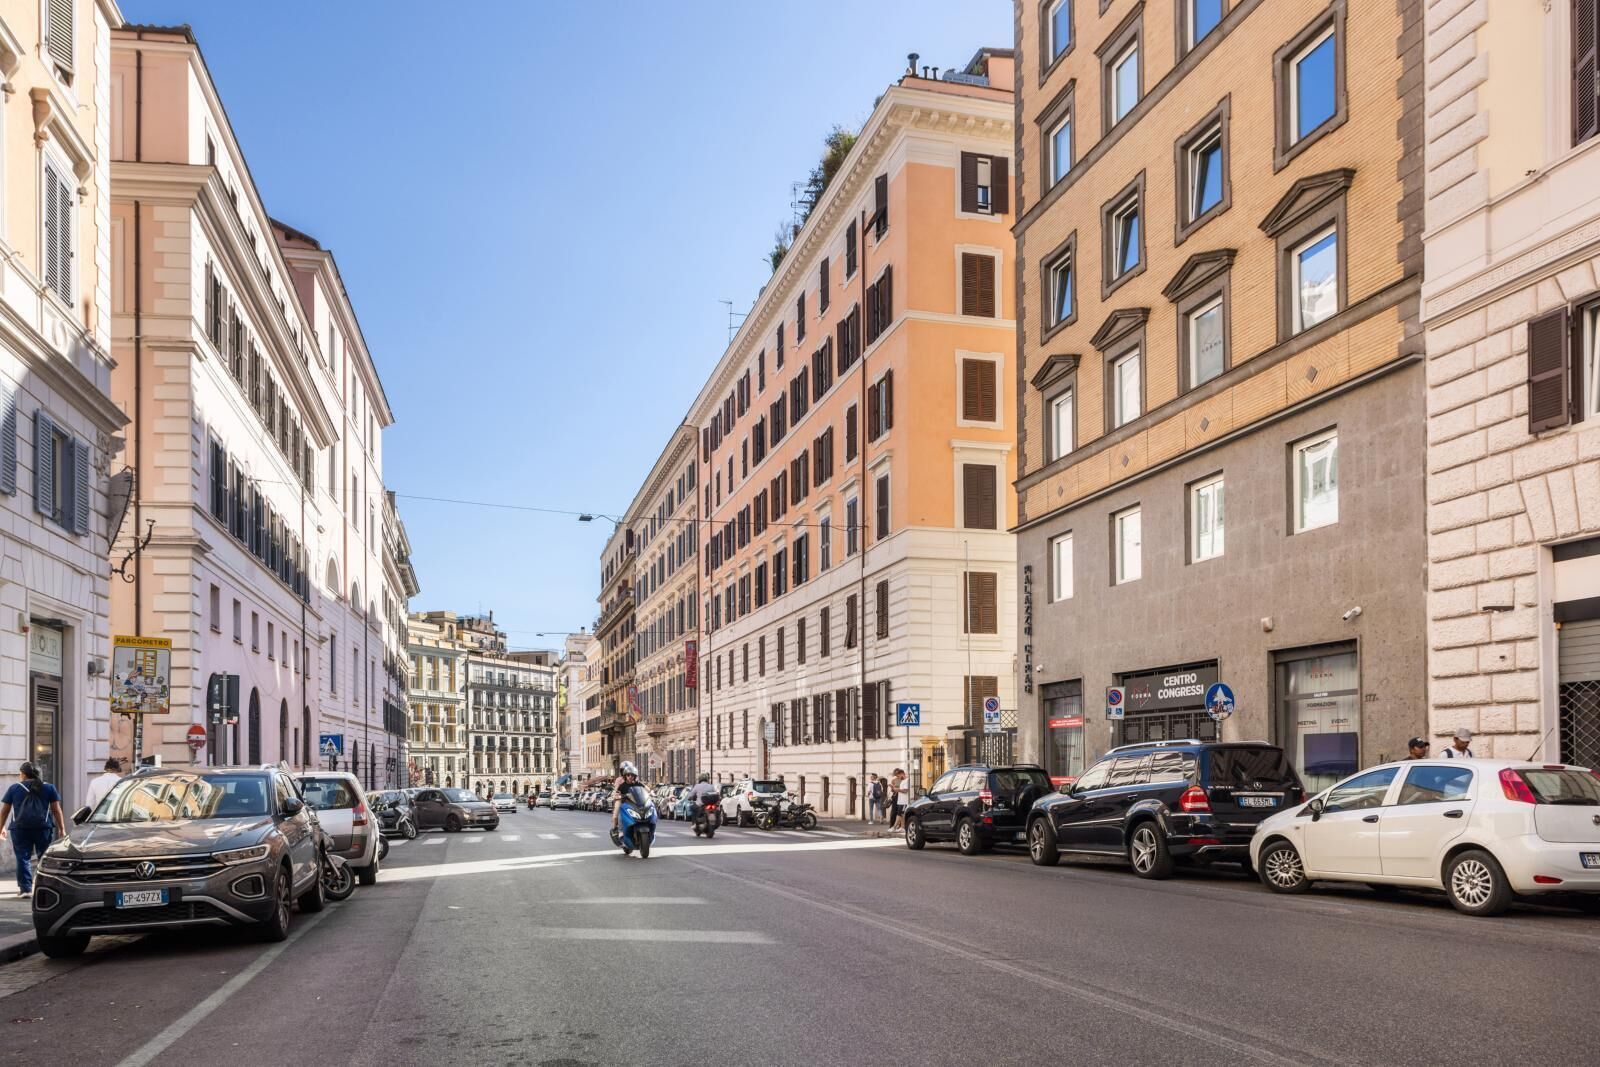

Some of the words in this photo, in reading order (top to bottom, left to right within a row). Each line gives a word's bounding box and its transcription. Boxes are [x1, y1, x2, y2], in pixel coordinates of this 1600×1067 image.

[1024, 565, 1032, 636] PALAZZO
[115, 637, 169, 646] PARCOMETRO
[1163, 673, 1197, 687] CENTRO
[1158, 684, 1204, 700] CONGRESSI
